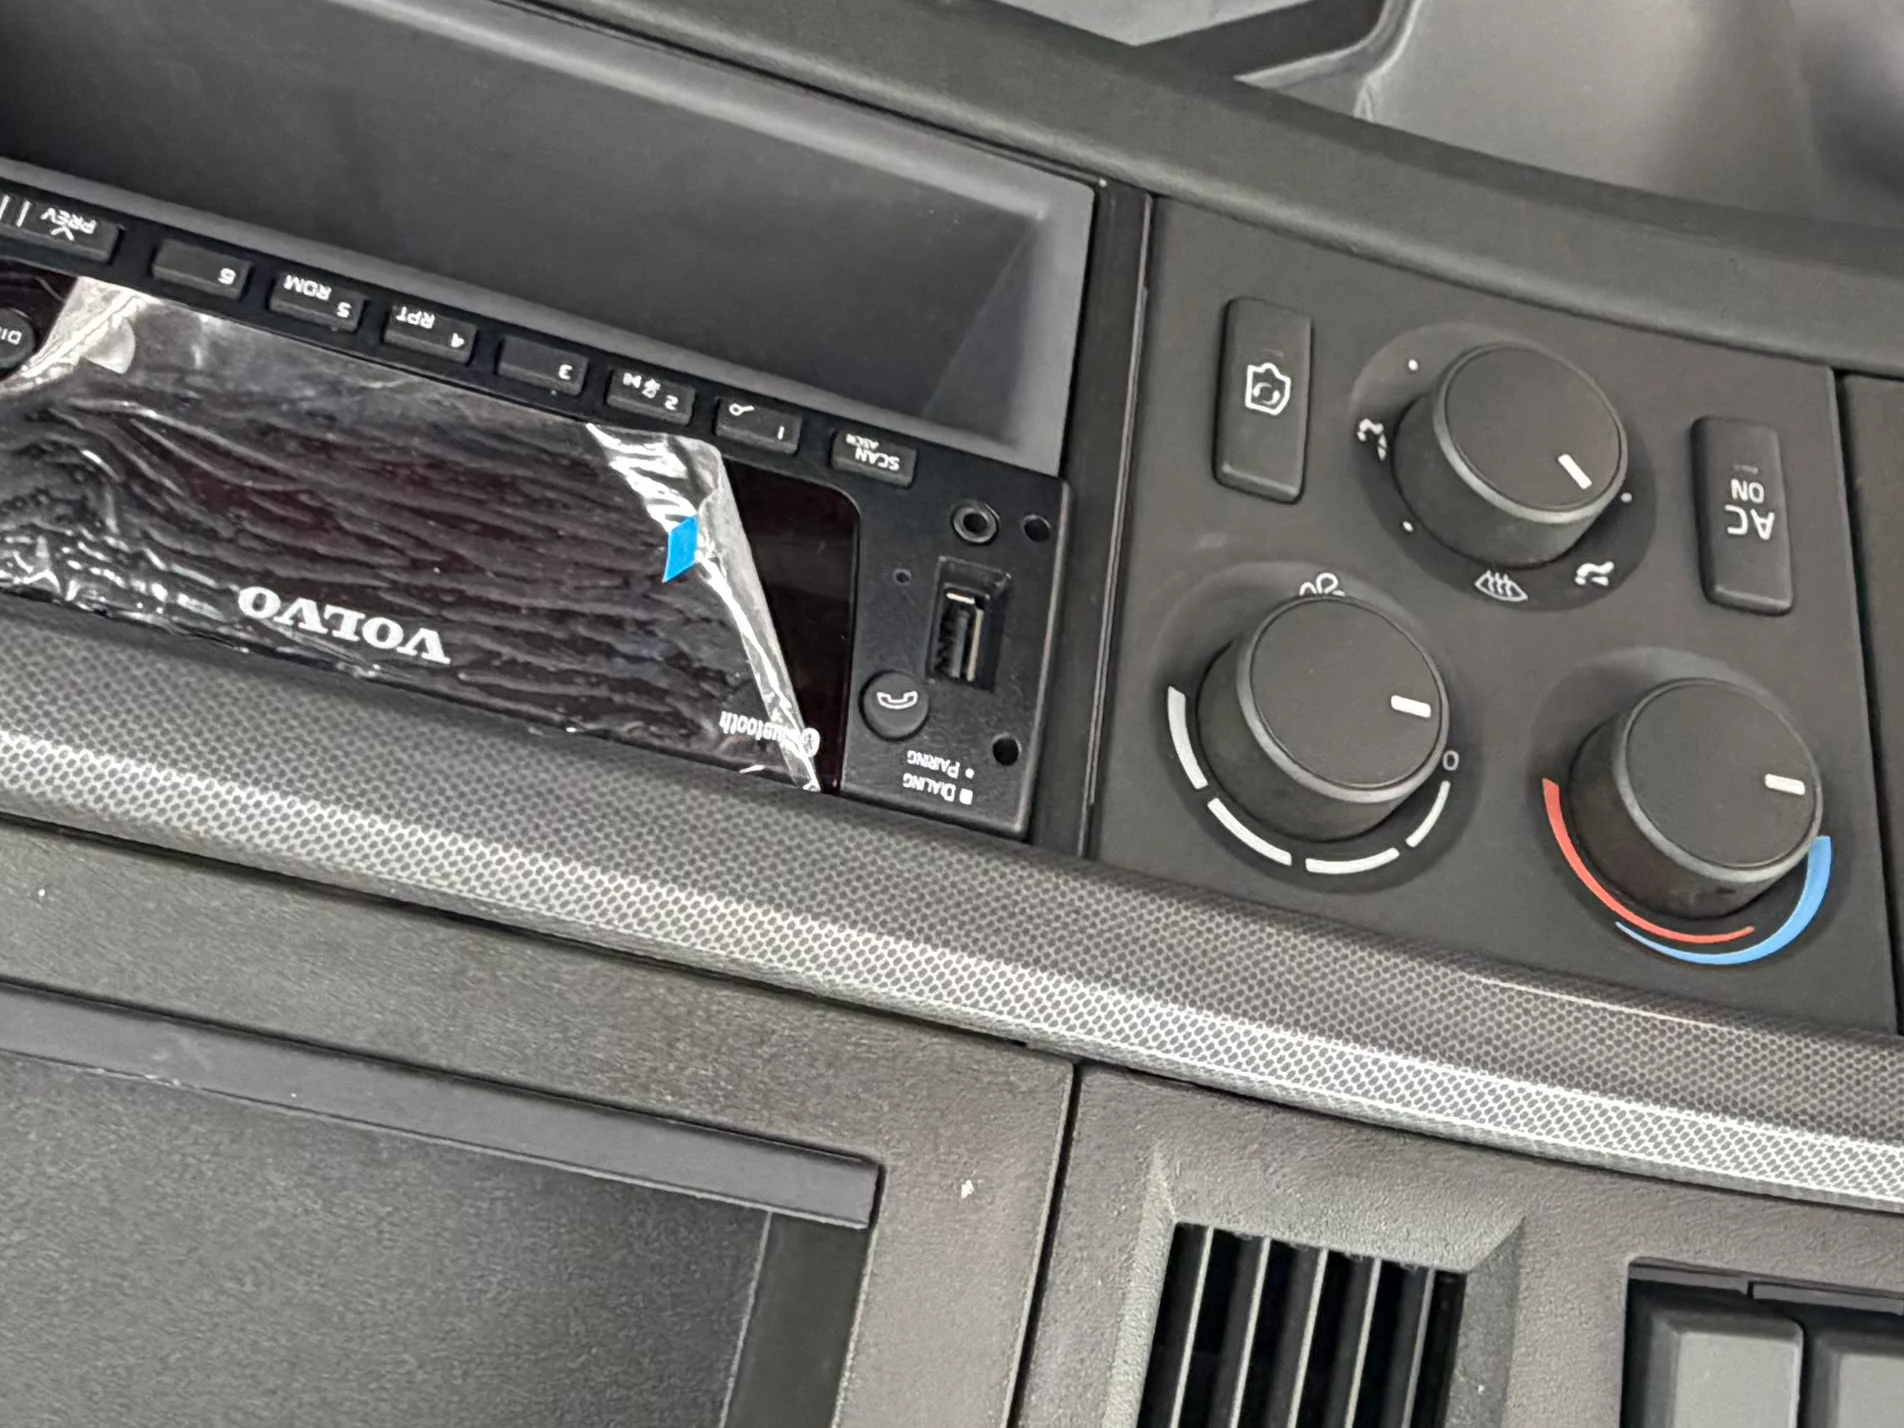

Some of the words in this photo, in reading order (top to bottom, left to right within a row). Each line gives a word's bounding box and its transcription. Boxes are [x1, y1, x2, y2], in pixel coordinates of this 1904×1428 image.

[40, 207, 97, 235] PREV
[218, 267, 236, 285] 6
[396, 305, 436, 330] RPT
[450, 332, 466, 348] 4
[558, 363, 573, 380] 3
[664, 395, 679, 411] 2
[854, 445, 901, 472] SCAN
[1731, 478, 1765, 504] ON
[1724, 504, 1775, 541] AC
[238, 586, 451, 664] VOLVO
[907, 750, 960, 779] PAIRING
[903, 772, 956, 802] DIALING
